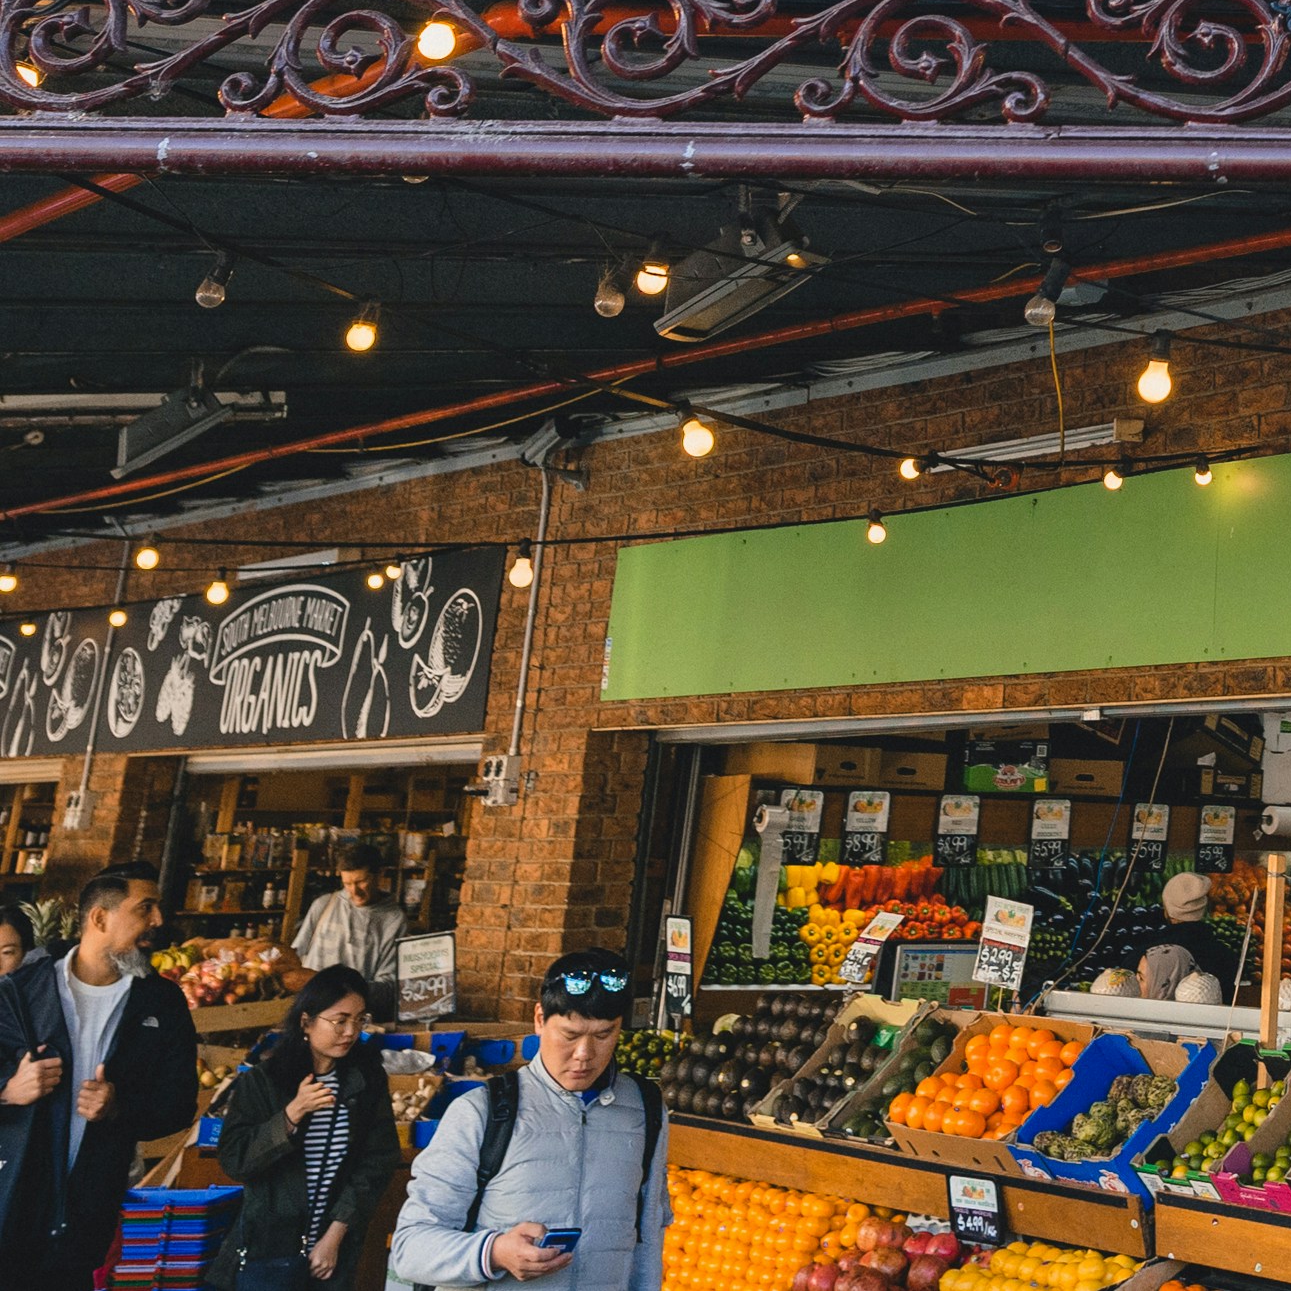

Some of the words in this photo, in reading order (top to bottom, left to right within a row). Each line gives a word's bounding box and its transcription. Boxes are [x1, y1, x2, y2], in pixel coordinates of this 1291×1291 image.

[221, 611, 251, 656] SOUTH
[303, 596, 343, 637] MARKET
[220, 649, 323, 734] ORGANICS
